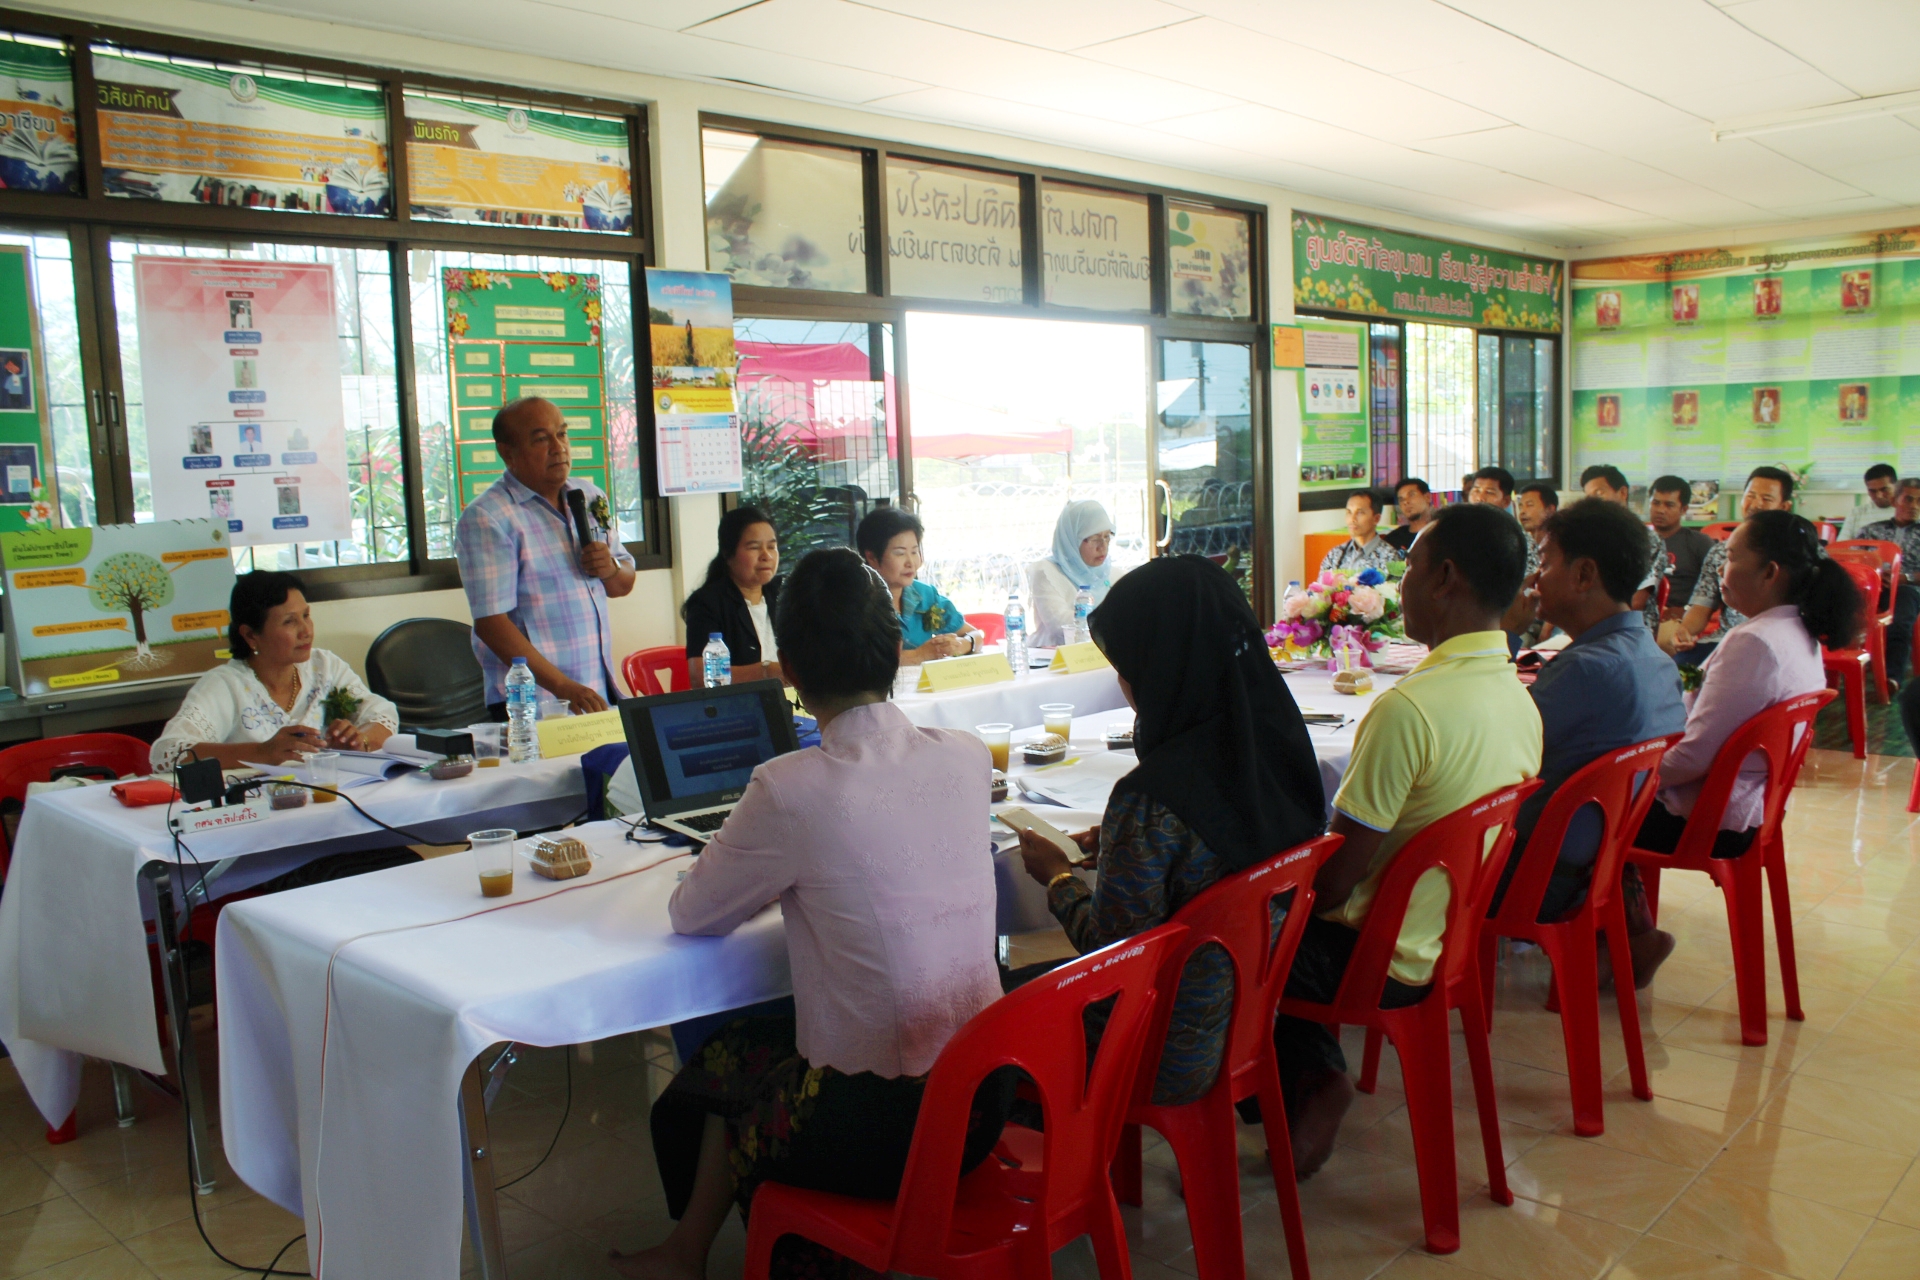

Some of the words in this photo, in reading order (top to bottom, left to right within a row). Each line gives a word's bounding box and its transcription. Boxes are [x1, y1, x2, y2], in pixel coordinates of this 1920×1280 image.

[97, 85, 171, 112] วิสัยทัศน์
[413, 121, 461, 143] พันธกิจ
[1306, 230, 1432, 282] ศูนย์ดิจิทัลชุมชน
[1438, 250, 1551, 295] เรียนรู้สู่ความสำเร็จ
[722, 792, 741, 802] ASUS
